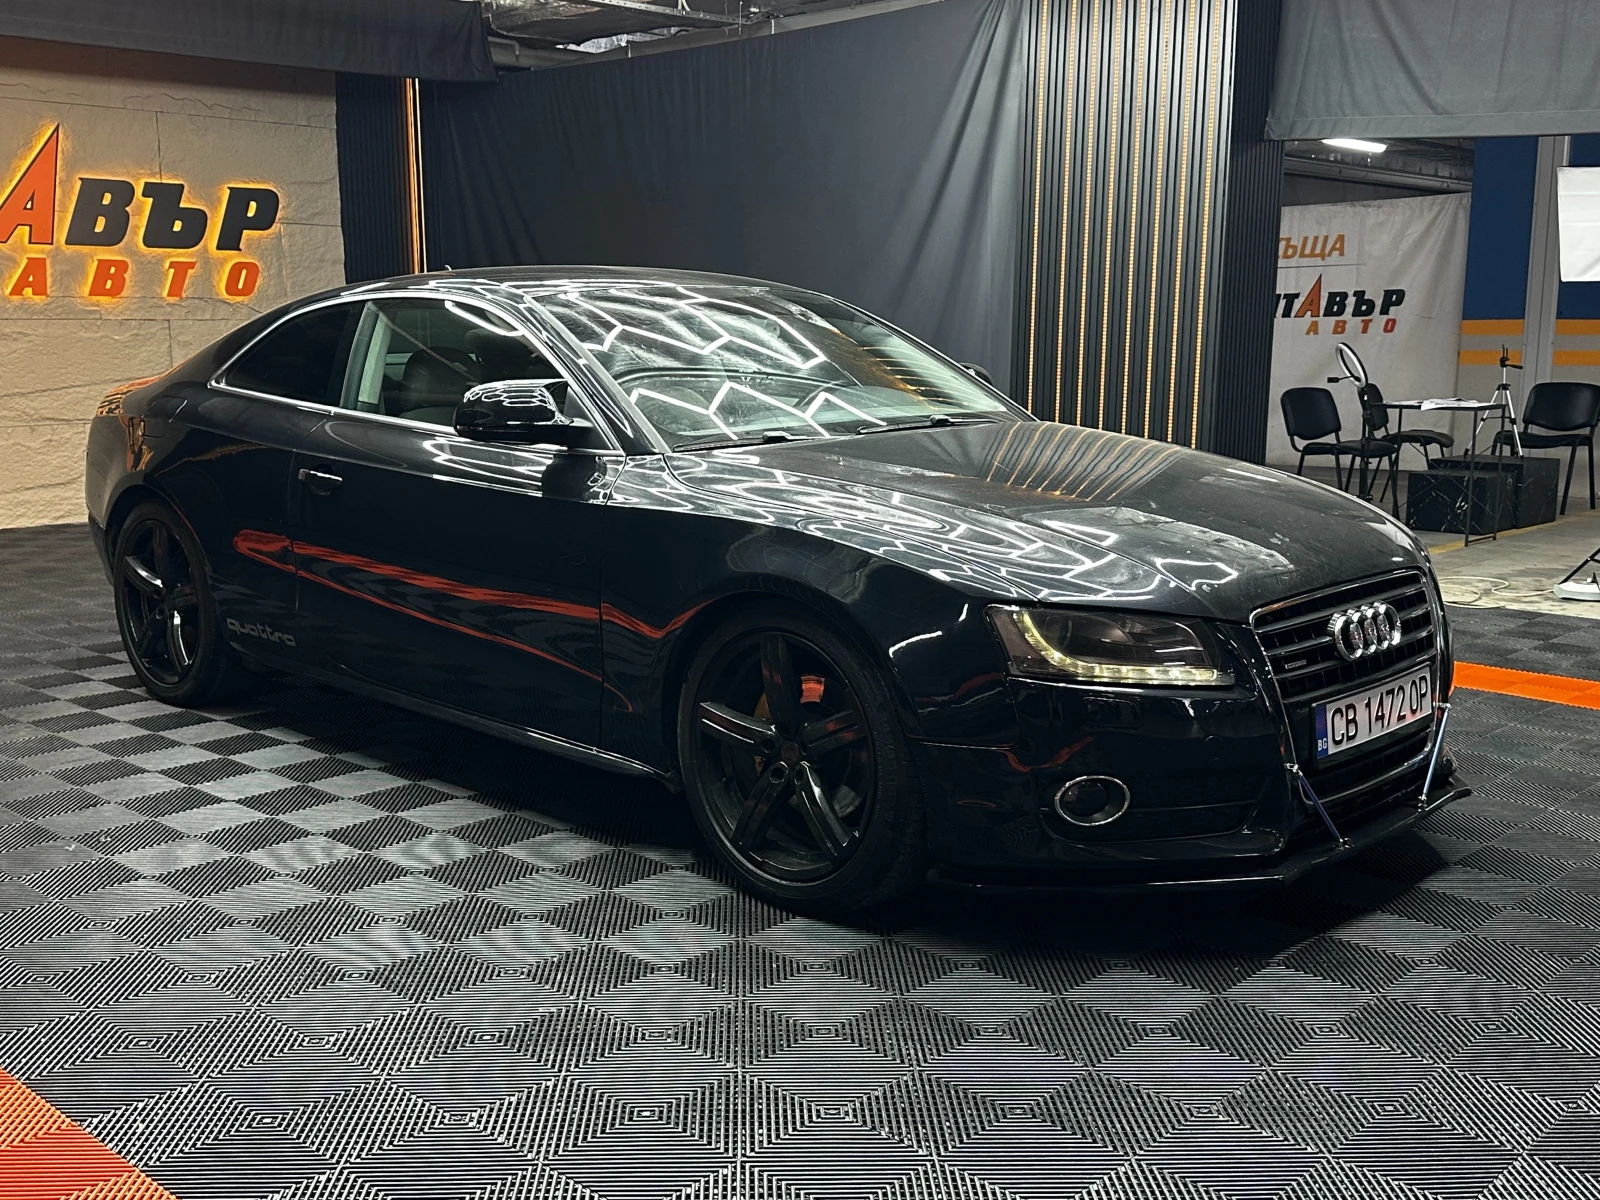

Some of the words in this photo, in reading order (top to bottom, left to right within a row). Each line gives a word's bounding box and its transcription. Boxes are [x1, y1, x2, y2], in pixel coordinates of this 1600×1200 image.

[1278, 234, 1345, 261] ЪЩА
[8, 257, 260, 298] АВТО
[1305, 318, 1397, 335] АВТО
[226, 617, 297, 647] quattro
[1364, 685, 1407, 734] 1472
[1317, 737, 1328, 751] BG
